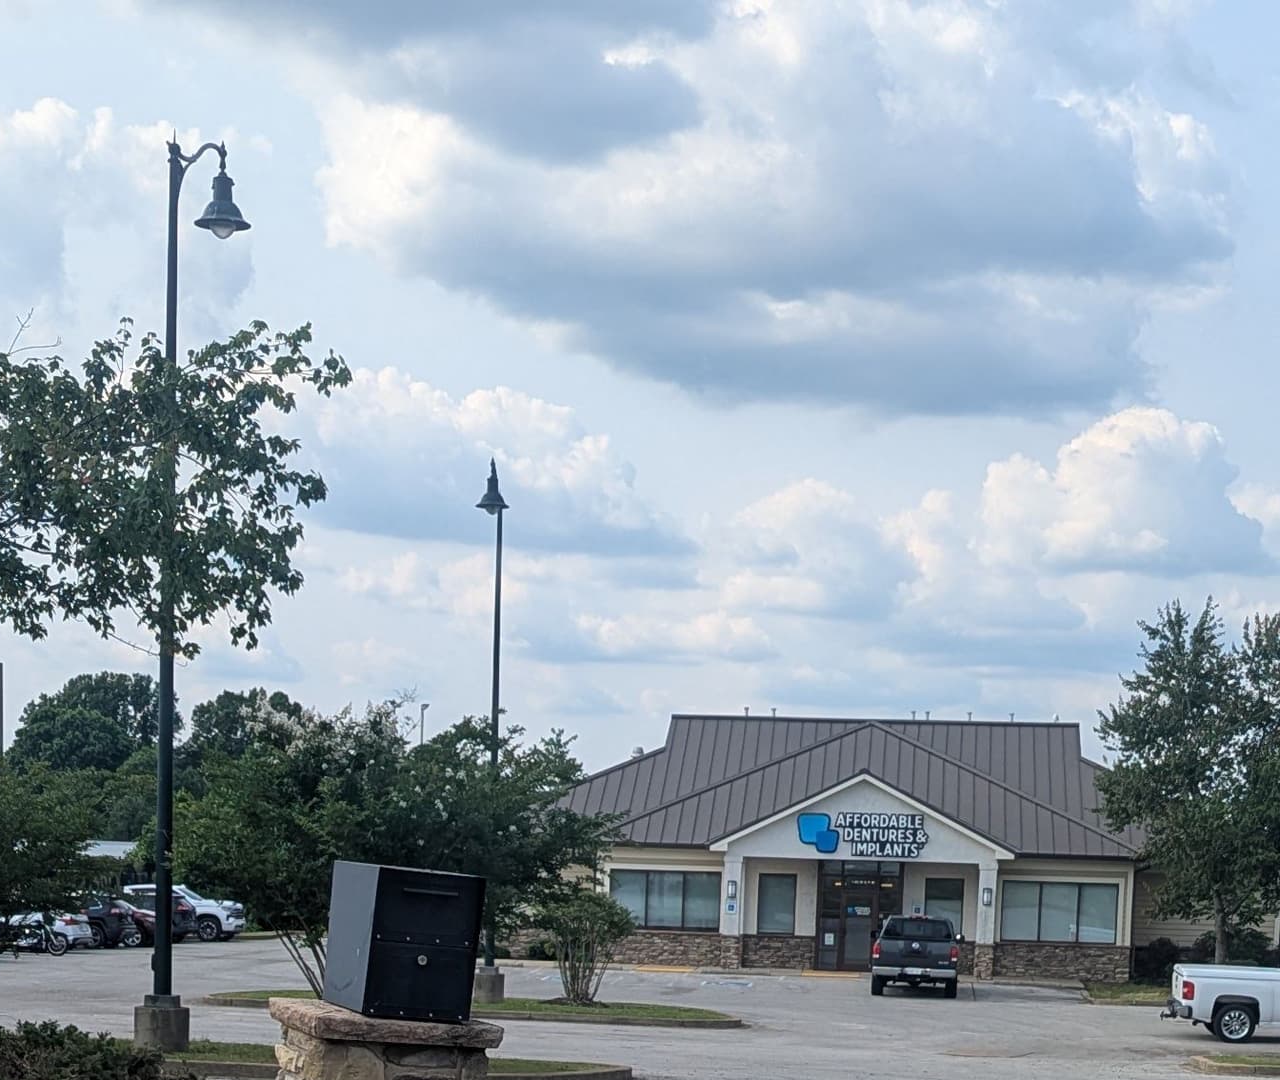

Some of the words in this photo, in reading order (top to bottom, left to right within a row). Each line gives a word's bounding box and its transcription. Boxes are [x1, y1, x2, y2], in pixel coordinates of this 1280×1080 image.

[835, 813, 923, 829] AFFORDABLE
[843, 828, 913, 843] DENTURES
[915, 830, 928, 844] &
[851, 842, 919, 858] IMPLANTS
